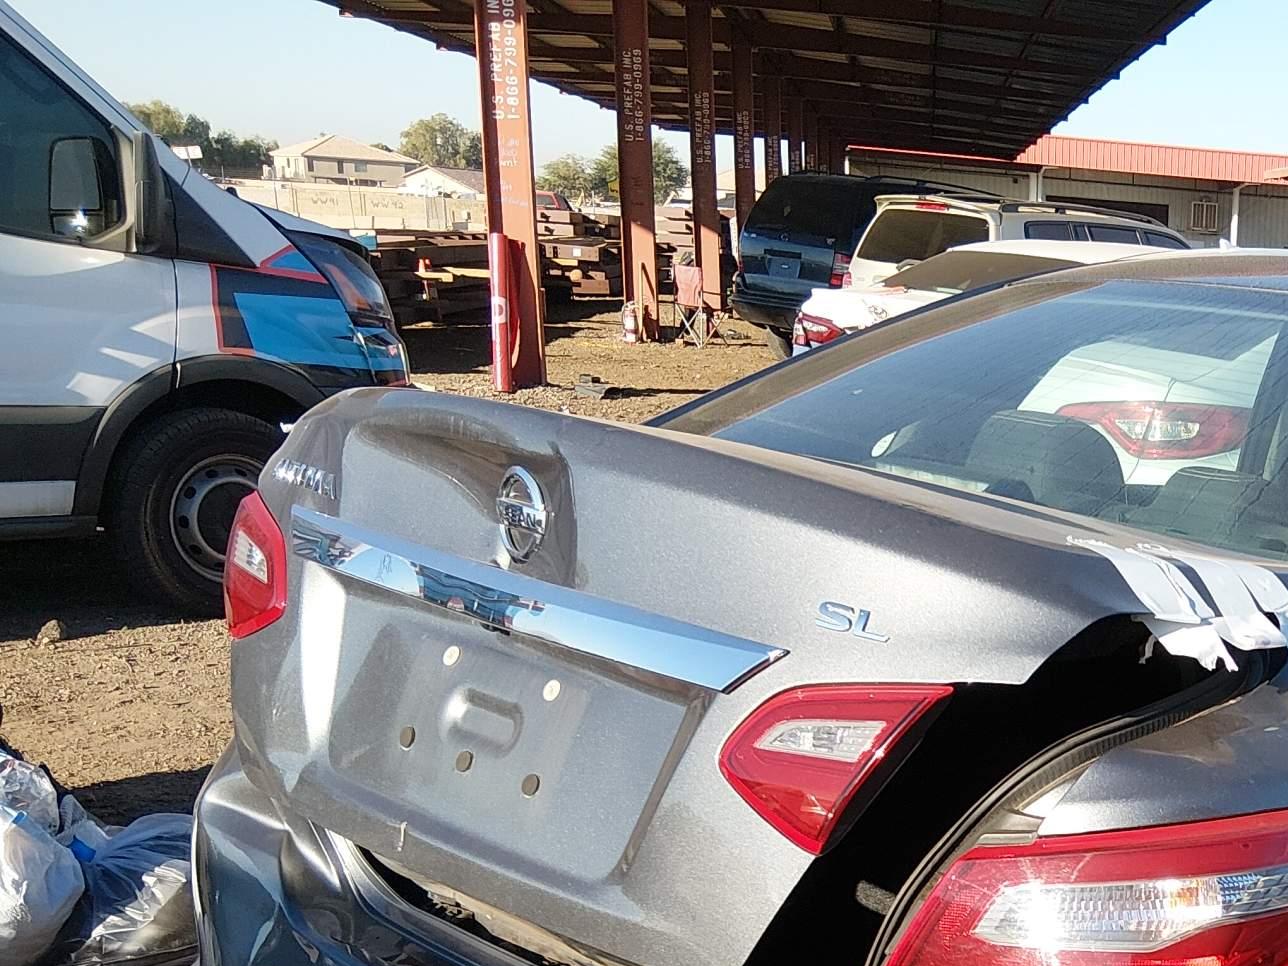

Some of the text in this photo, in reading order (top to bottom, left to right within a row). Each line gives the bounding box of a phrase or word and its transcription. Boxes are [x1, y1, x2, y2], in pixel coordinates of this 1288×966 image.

[488, 22, 503, 82] PREFAB
[491, 90, 505, 120] U.S.
[623, 73, 634, 115] PREFAB
[624, 120, 634, 142] U.S.
[816, 601, 891, 643] SL
